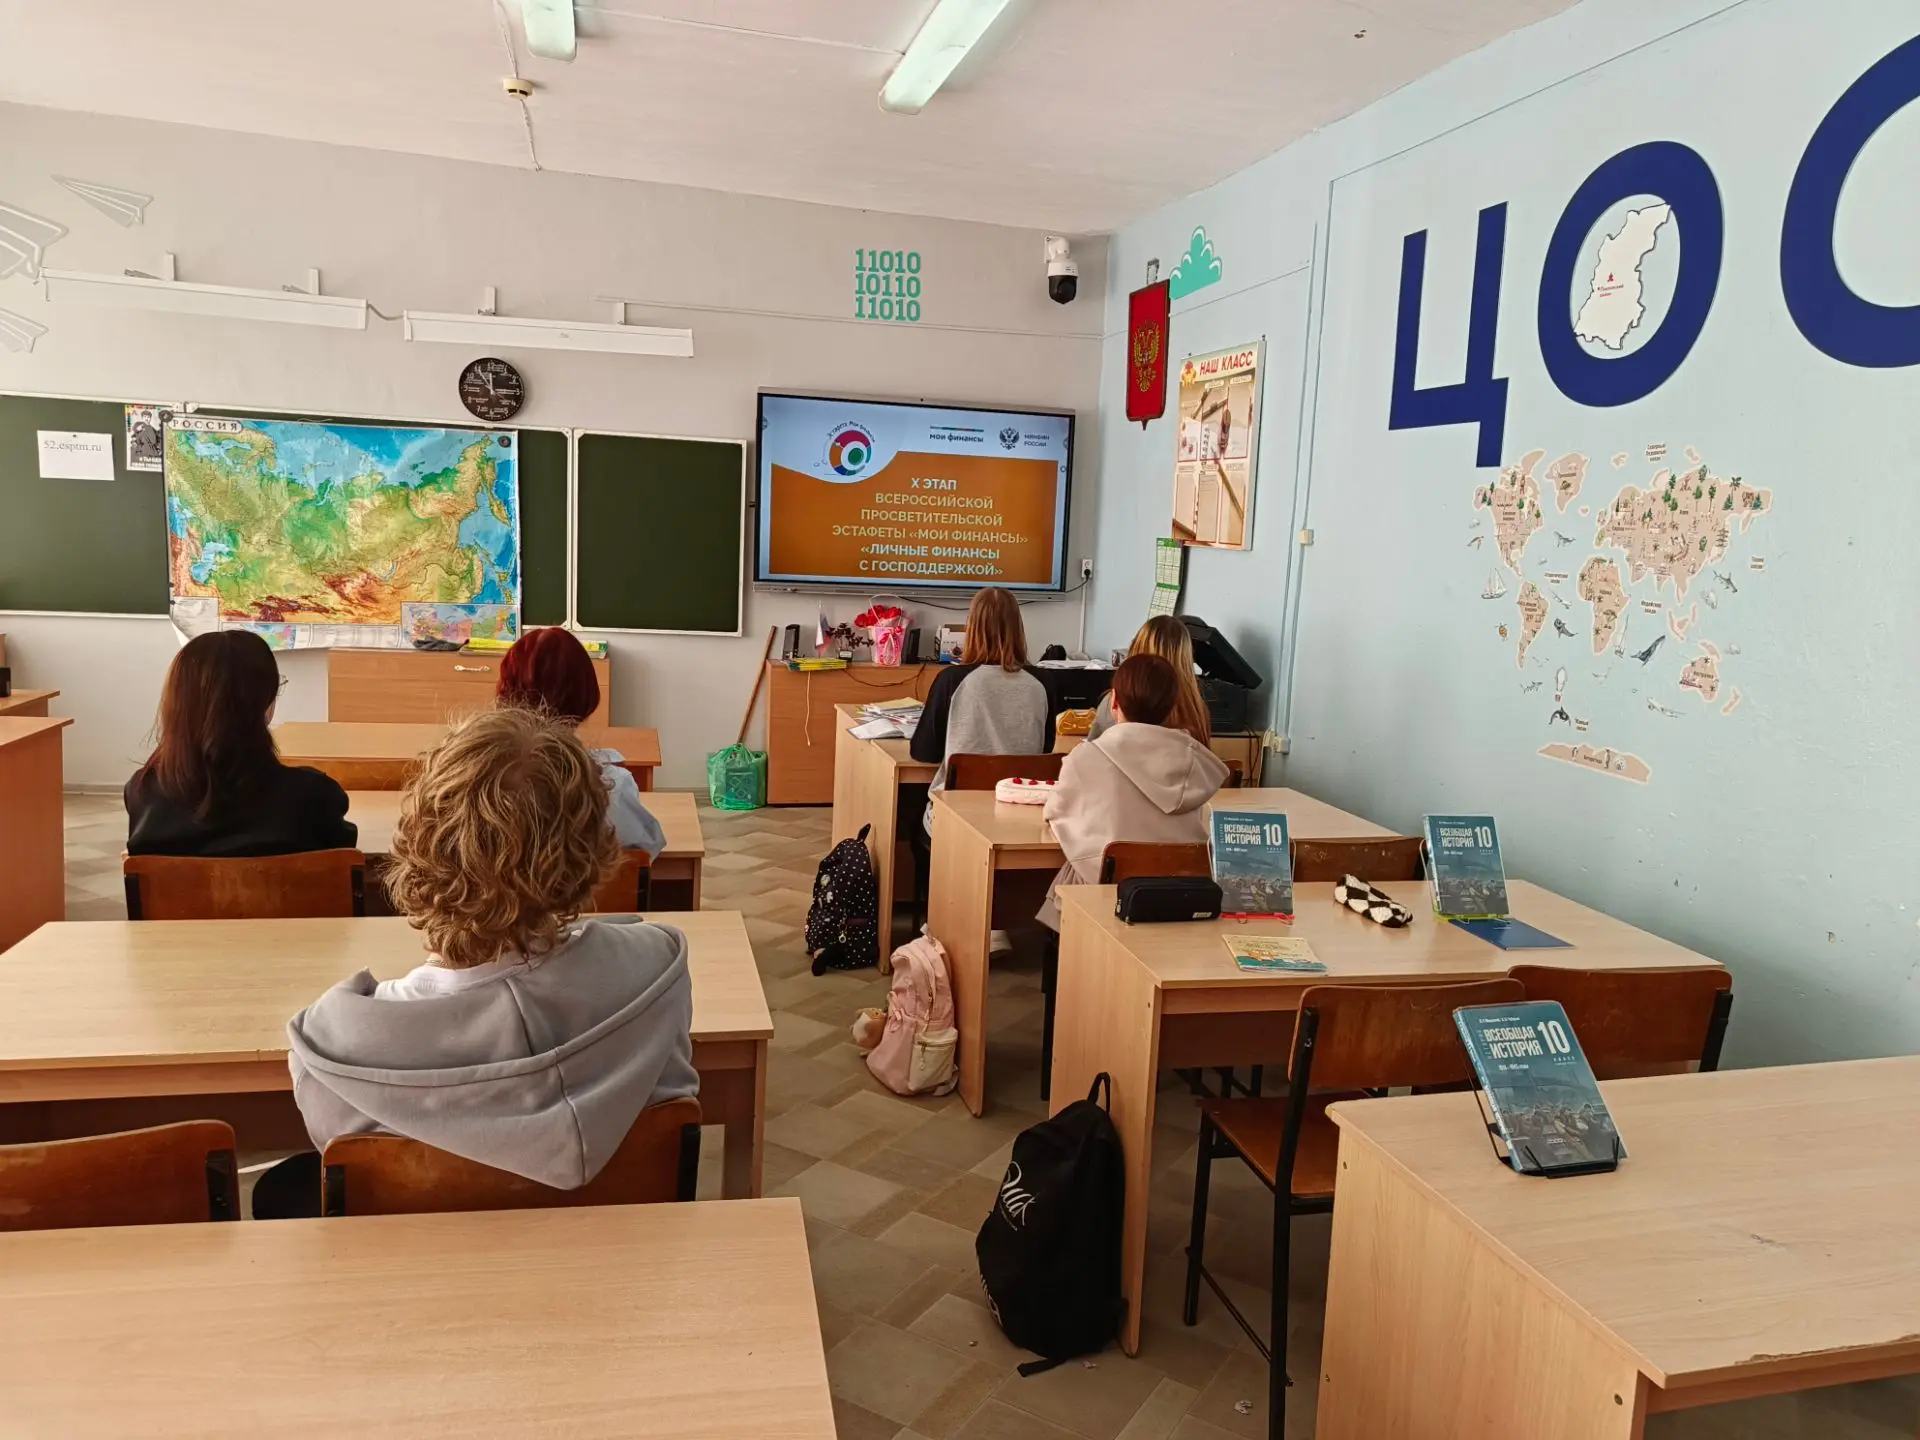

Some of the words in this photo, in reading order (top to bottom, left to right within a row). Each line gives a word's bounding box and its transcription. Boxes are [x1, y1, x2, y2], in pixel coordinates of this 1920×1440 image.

[855, 248, 921, 274] 11010
[855, 272, 921, 298] 10110
[855, 296, 921, 322] 11010
[1200, 359, 1219, 375] НАШ
[1221, 351, 1253, 371] КЛАСС
[172, 419, 238, 431] РОССИЯ
[947, 433, 984, 442] финансы
[923, 478, 957, 490] ЭТАП
[875, 493, 993, 509] ВСЕРОССИЙСКОЙ
[861, 509, 1003, 527] ПРОСВЕТИТЕЛЬСКОЙ
[832, 525, 906, 539] ЭСТАФЕТЫ
[909, 528, 948, 541] «МОИ
[951, 530, 1029, 544] ФИНАНСЫ»
[861, 543, 929, 557] «ЛИЧНЫЕ
[931, 545, 1000, 559] ФИНАНСЫ
[859, 560, 868, 571] С
[871, 560, 1004, 576] ГОСПОДДЕРЖКОЙ»
[1223, 824, 1261, 834] ВСЕОБЩАЯ
[1263, 823, 1282, 846] 10
[1440, 827, 1473, 837] ВСЕОБЩАЯ
[1474, 826, 1492, 848] 10
[1224, 834, 1261, 845] ИСТОРИЯ
[1441, 837, 1474, 848] ИСТОРИЯ
[1483, 1026, 1536, 1042] ВСЕОБЩАЯ
[1537, 1020, 1571, 1054] 10
[1489, 1040, 1543, 1059] ИСТОРИЯ
